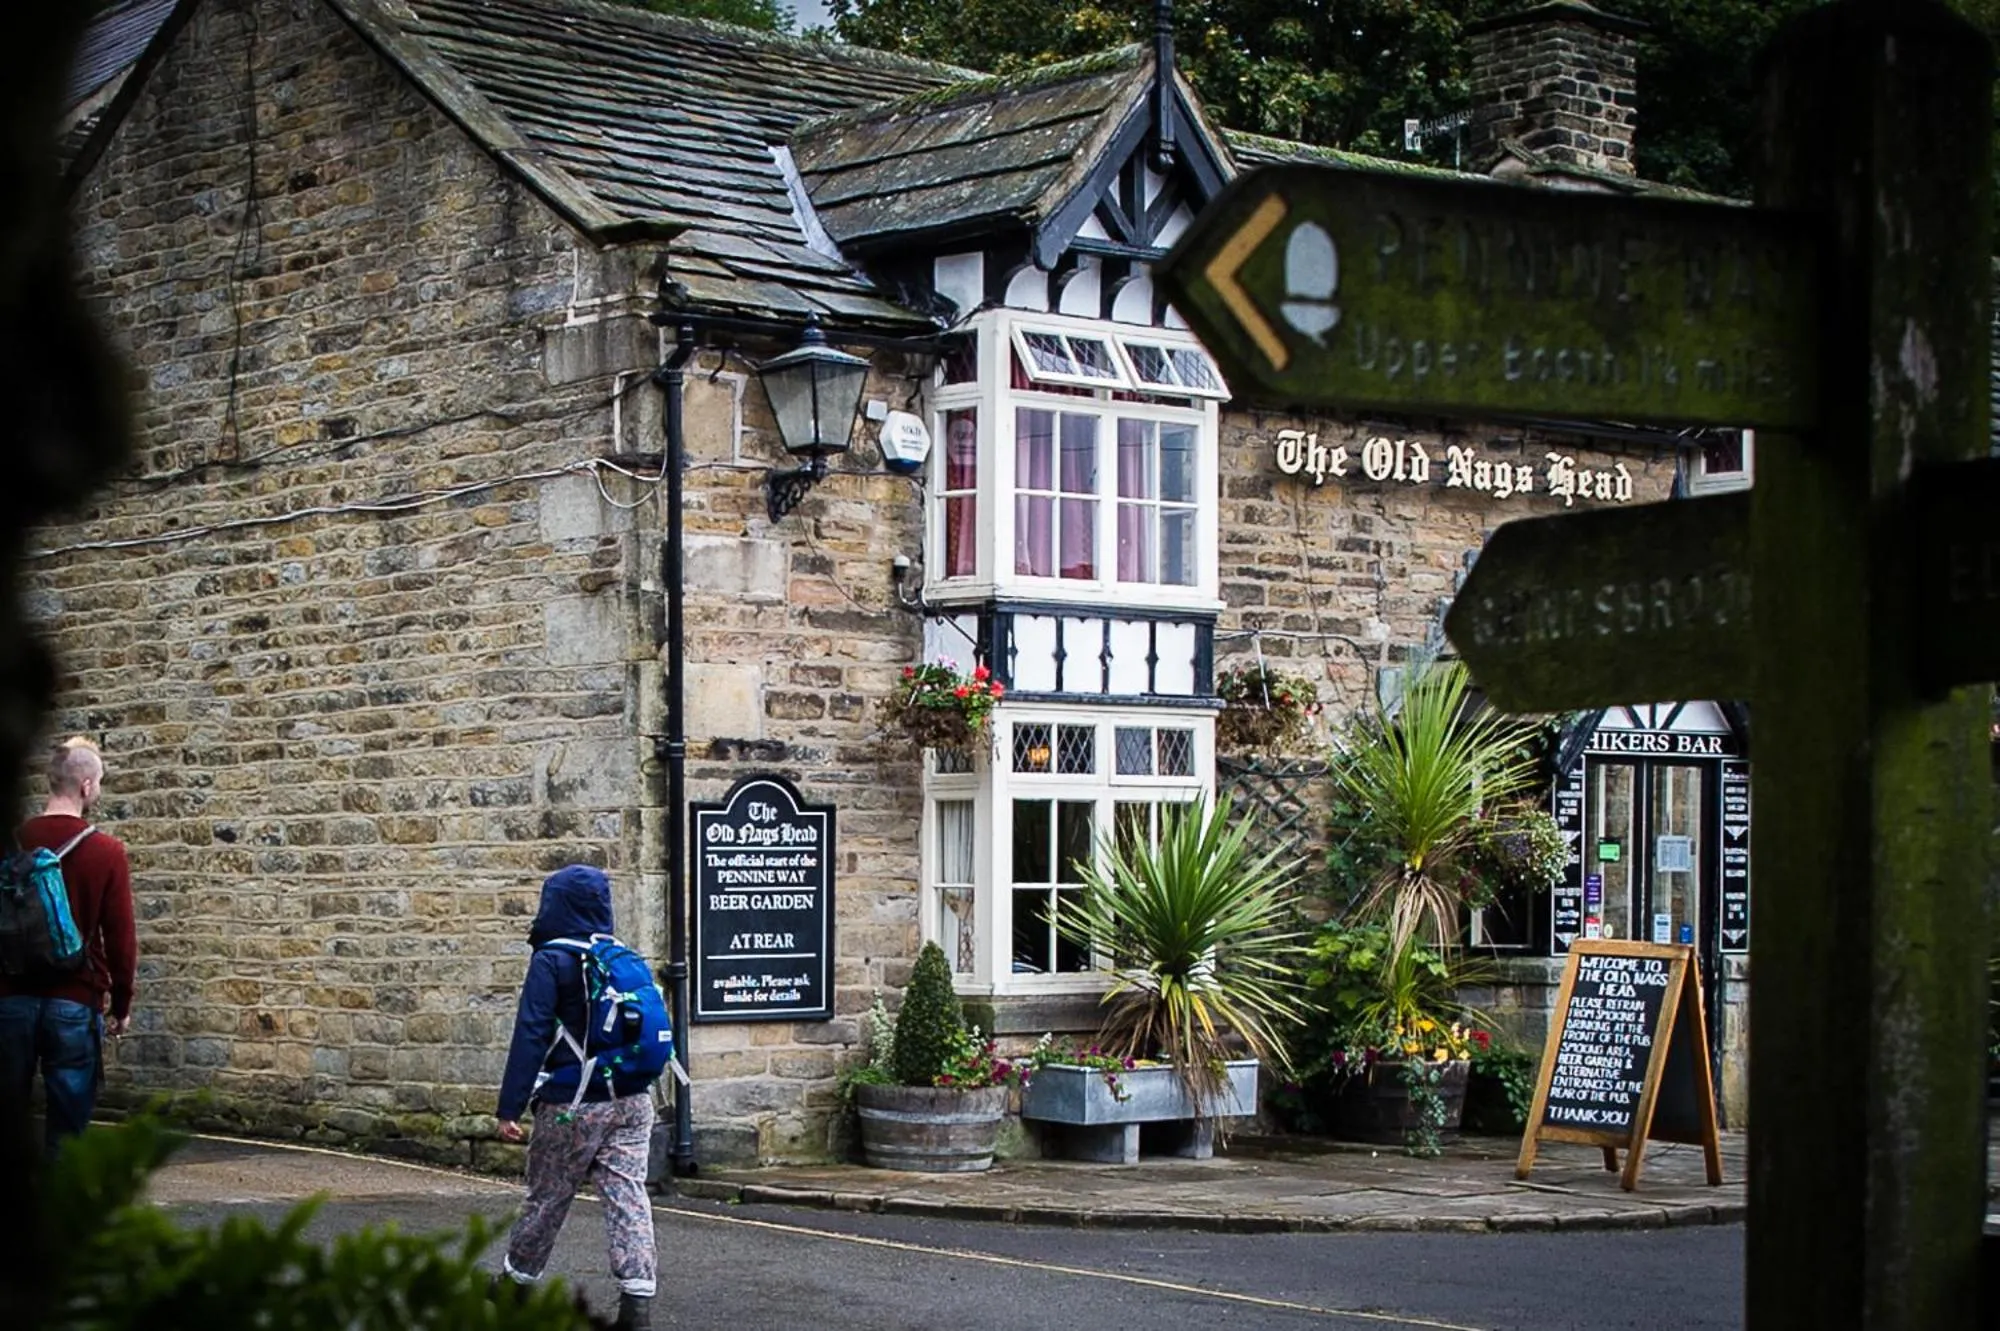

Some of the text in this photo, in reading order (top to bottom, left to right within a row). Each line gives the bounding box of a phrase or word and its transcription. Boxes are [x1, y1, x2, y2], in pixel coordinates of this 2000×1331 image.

[1355, 321, 1480, 382] Upper
[1276, 430, 1634, 507] The Old Nags Head
[1587, 731, 1723, 753] HIKERS BAR
[747, 801, 778, 823] The
[706, 822, 818, 846] Old Nags Head
[705, 854, 817, 867] The official start of the
[717, 869, 806, 884] PENNINE WAY
[709, 894, 814, 911] BEER GARDEN
[729, 932, 795, 950] AT REAR
[1580, 956, 1662, 973] WELCOME TO
[761, 974, 793, 988] Please
[793, 973, 811, 987] ask
[1578, 967, 1669, 987] THE OLD NAGS
[723, 988, 801, 1003] inside for details
[1598, 982, 1637, 998] HEAD
[1570, 996, 1645, 1011] PLEASE REFRAIN
[1568, 1007, 1594, 1019] FROM
[1595, 1009, 1636, 1022] SMOKING
[1566, 1018, 1645, 1034] DRINKING AT THE
[1562, 1029, 1652, 1047] FRONT OF THE PUB
[1560, 1041, 1604, 1055] SMOKING
[1557, 1053, 1583, 1066] BEER
[1584, 1055, 1623, 1069] GARDEN
[1555, 1064, 1622, 1080] ALTERNATIVE
[1552, 1075, 1644, 1094] ENTRANCES AT THE
[1549, 1087, 1631, 1105] REAR OF THE PUB
[1549, 1105, 1631, 1126] THANK YOU
